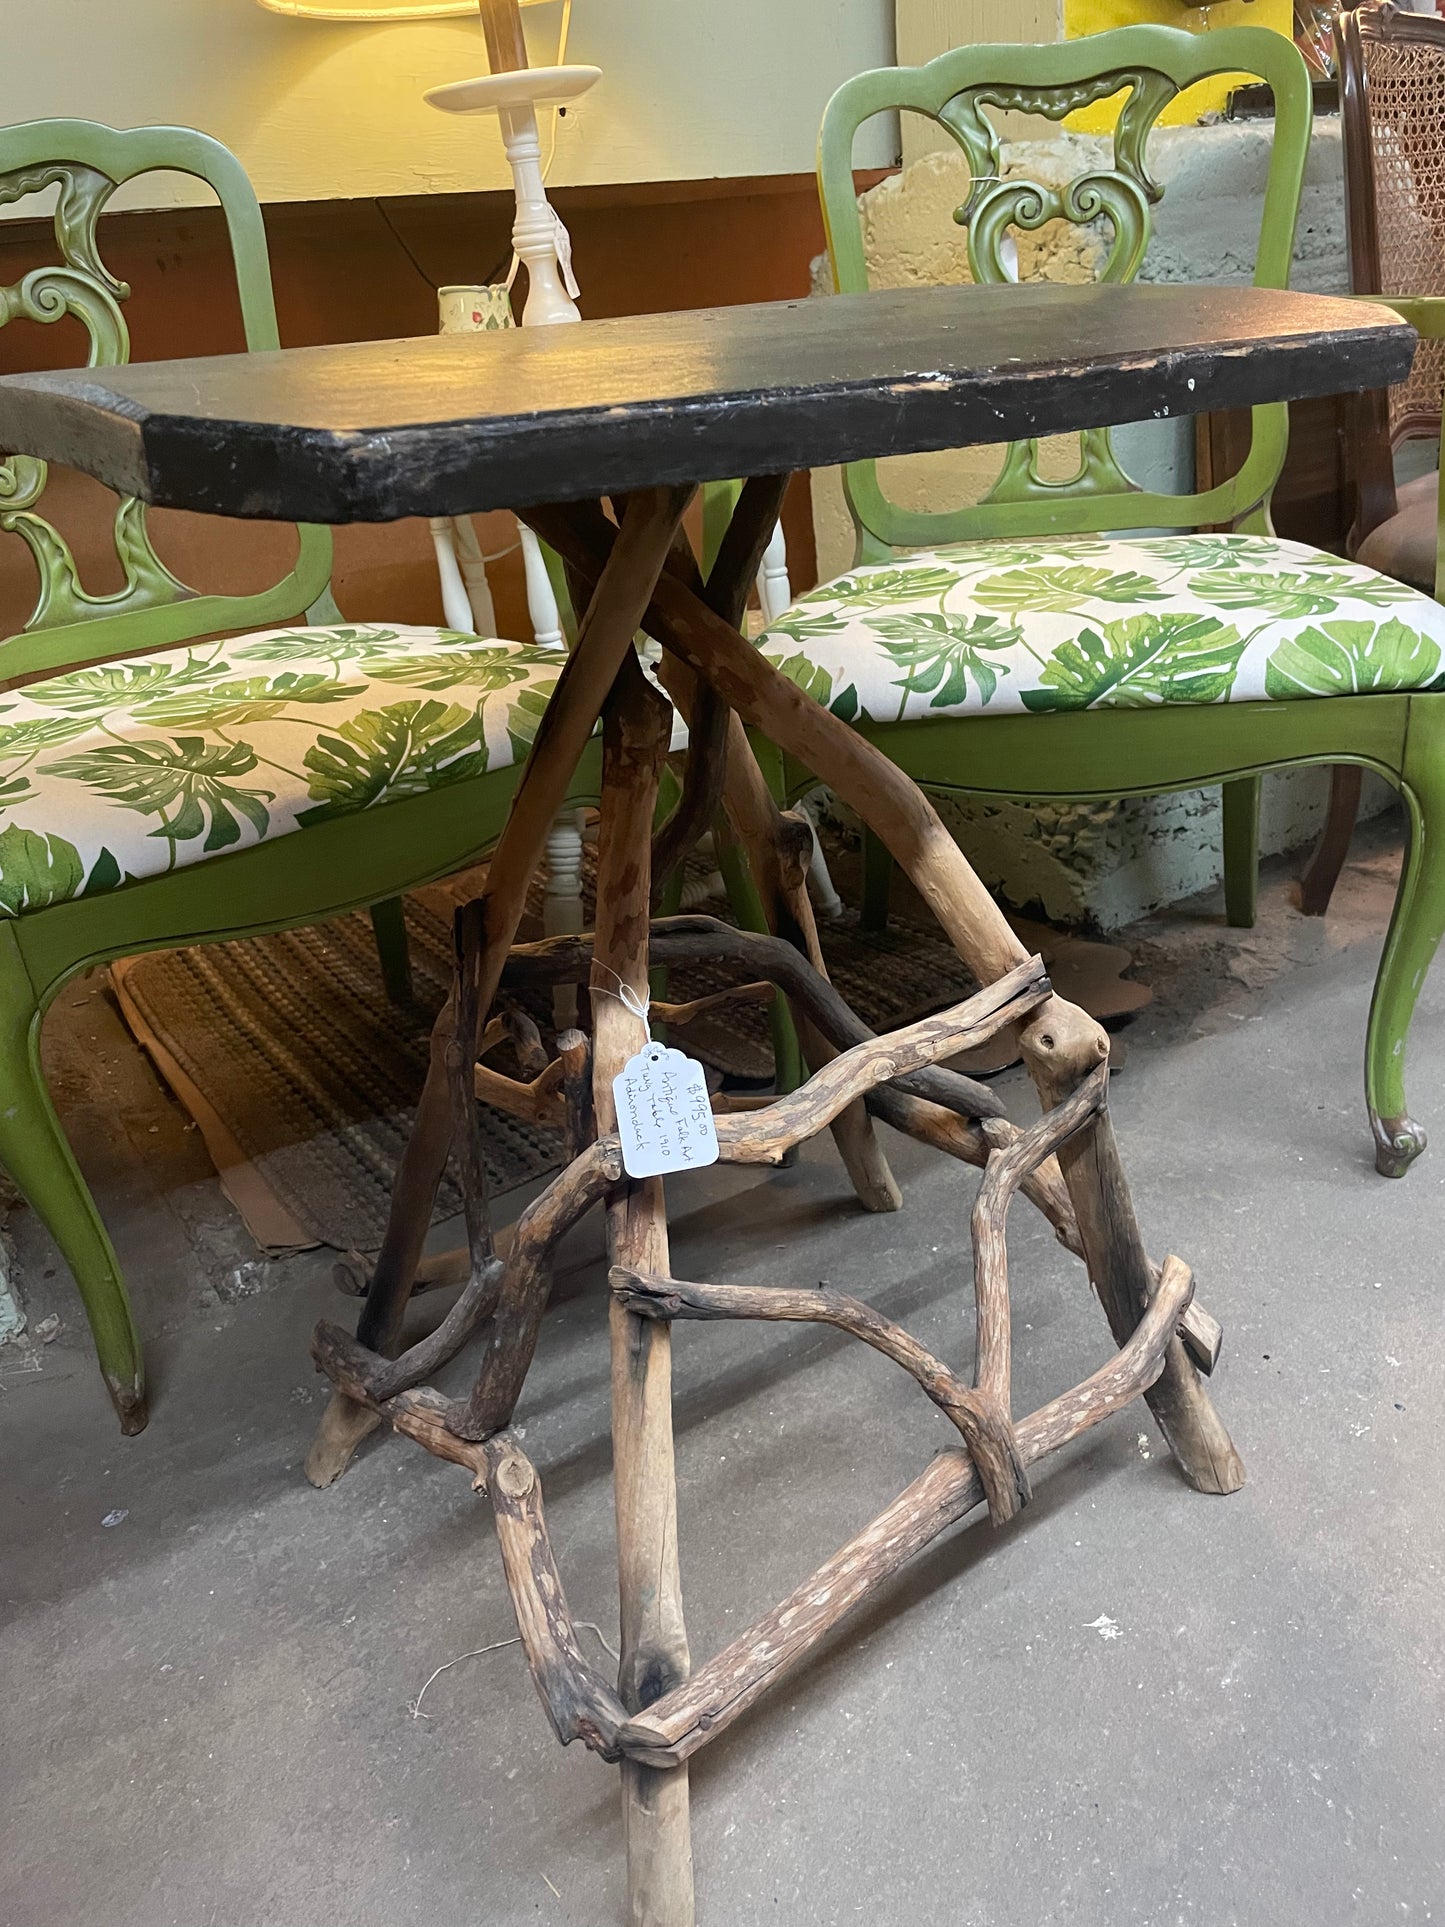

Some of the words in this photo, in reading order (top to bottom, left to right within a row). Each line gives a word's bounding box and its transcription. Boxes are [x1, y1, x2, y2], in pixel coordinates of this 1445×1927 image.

[625, 1078, 651, 1151] Adirondack
[647, 1093, 664, 1128] Table
[660, 1134, 670, 1156] 1910
[658, 1071, 678, 1115] Antique
[681, 1146, 694, 1161] Art
